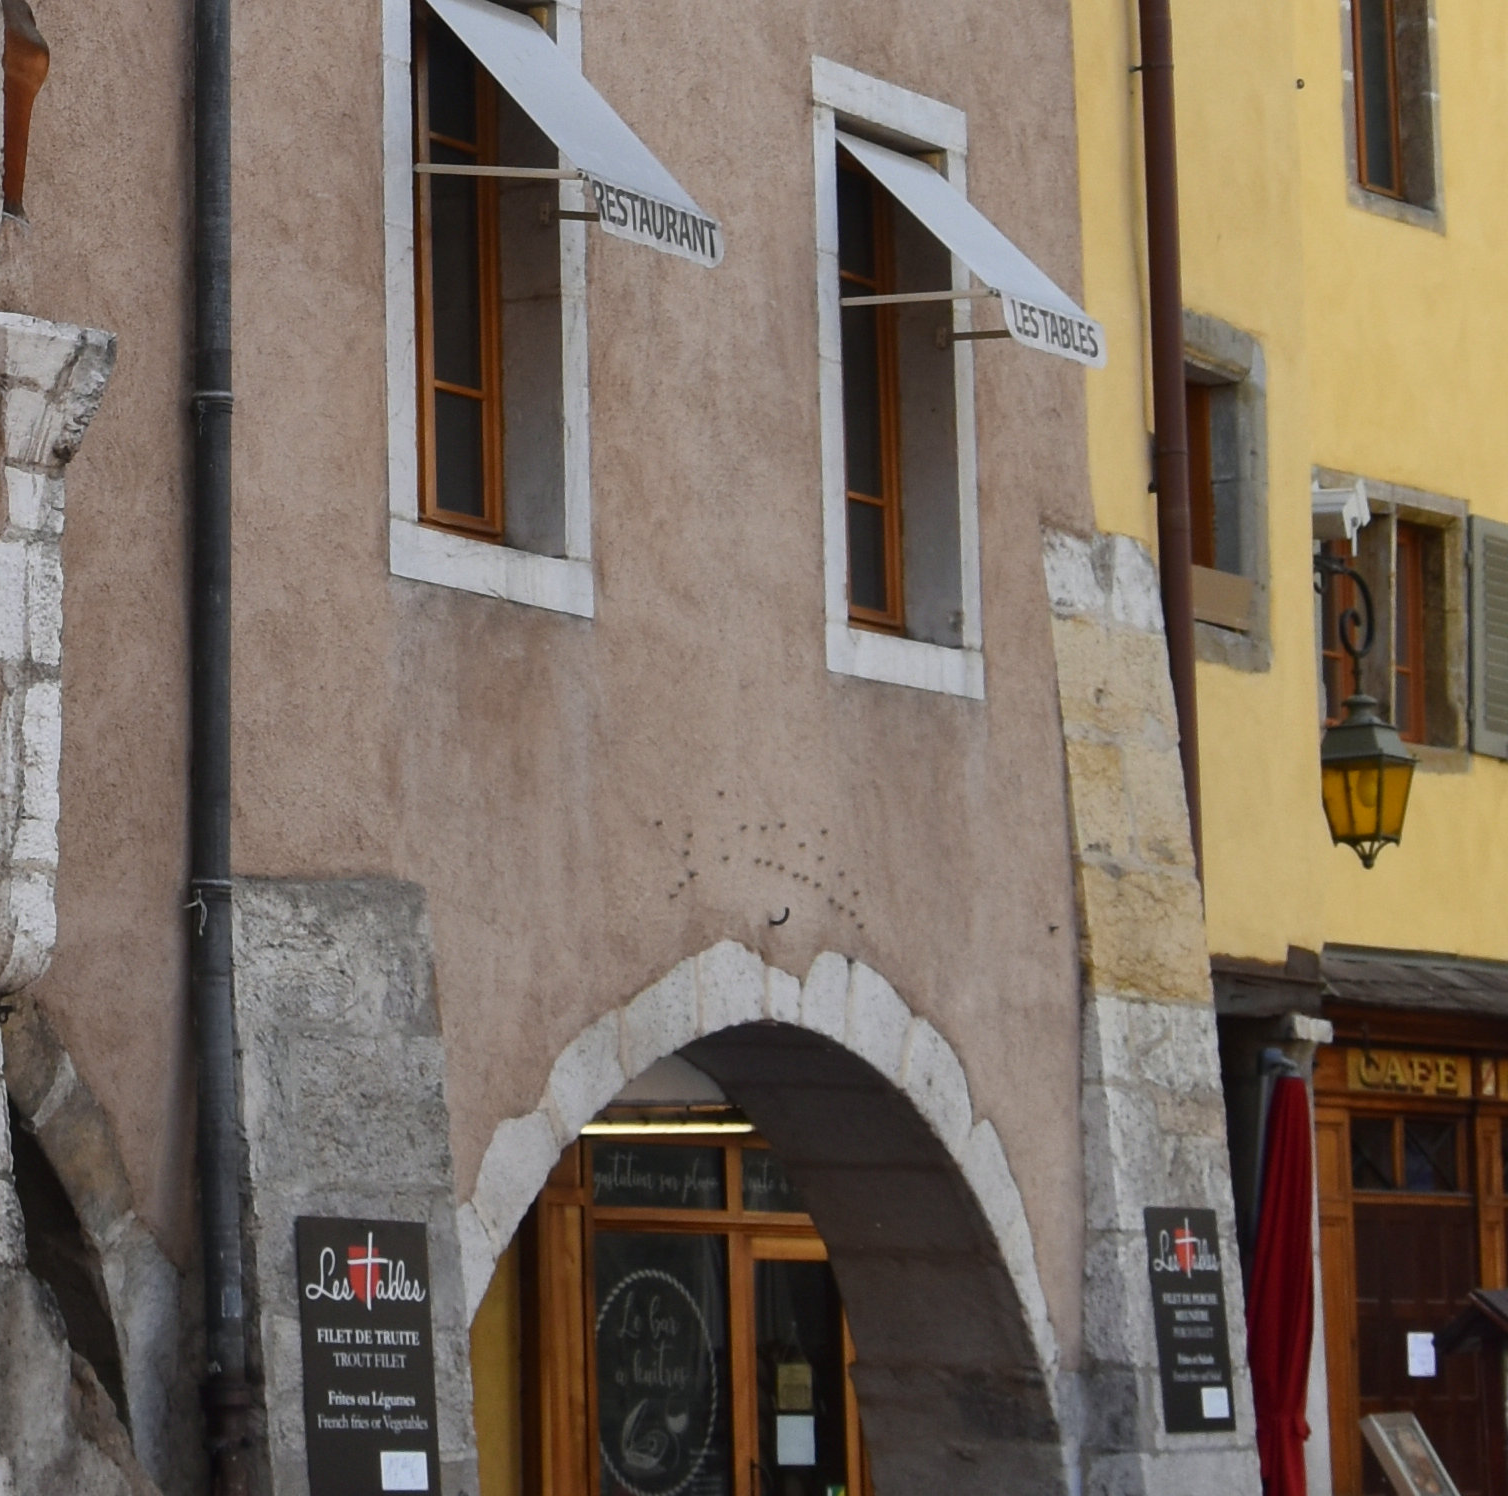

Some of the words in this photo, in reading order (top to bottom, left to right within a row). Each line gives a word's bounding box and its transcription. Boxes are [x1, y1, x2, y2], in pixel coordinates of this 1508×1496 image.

[592, 179, 717, 260] RESTAURANT
[1010, 298, 1040, 340] LES
[1038, 308, 1099, 359] TABLES
[1152, 1229, 1182, 1272] Les
[305, 1246, 356, 1302] Les
[317, 1328, 353, 1345] FILET
[355, 1328, 373, 1345] DE
[375, 1330, 420, 1347] TRUITE
[333, 1352, 373, 1368] TROUT
[374, 1353, 407, 1369] FILET
[328, 1390, 355, 1406] Frites
[357, 1394, 370, 1406] ou
[372, 1390, 416, 1411] Légumes
[317, 1413, 349, 1429] French
[351, 1413, 370, 1429] fries
[371, 1417, 382, 1429] or
[383, 1413, 429, 1435] Vegetables
